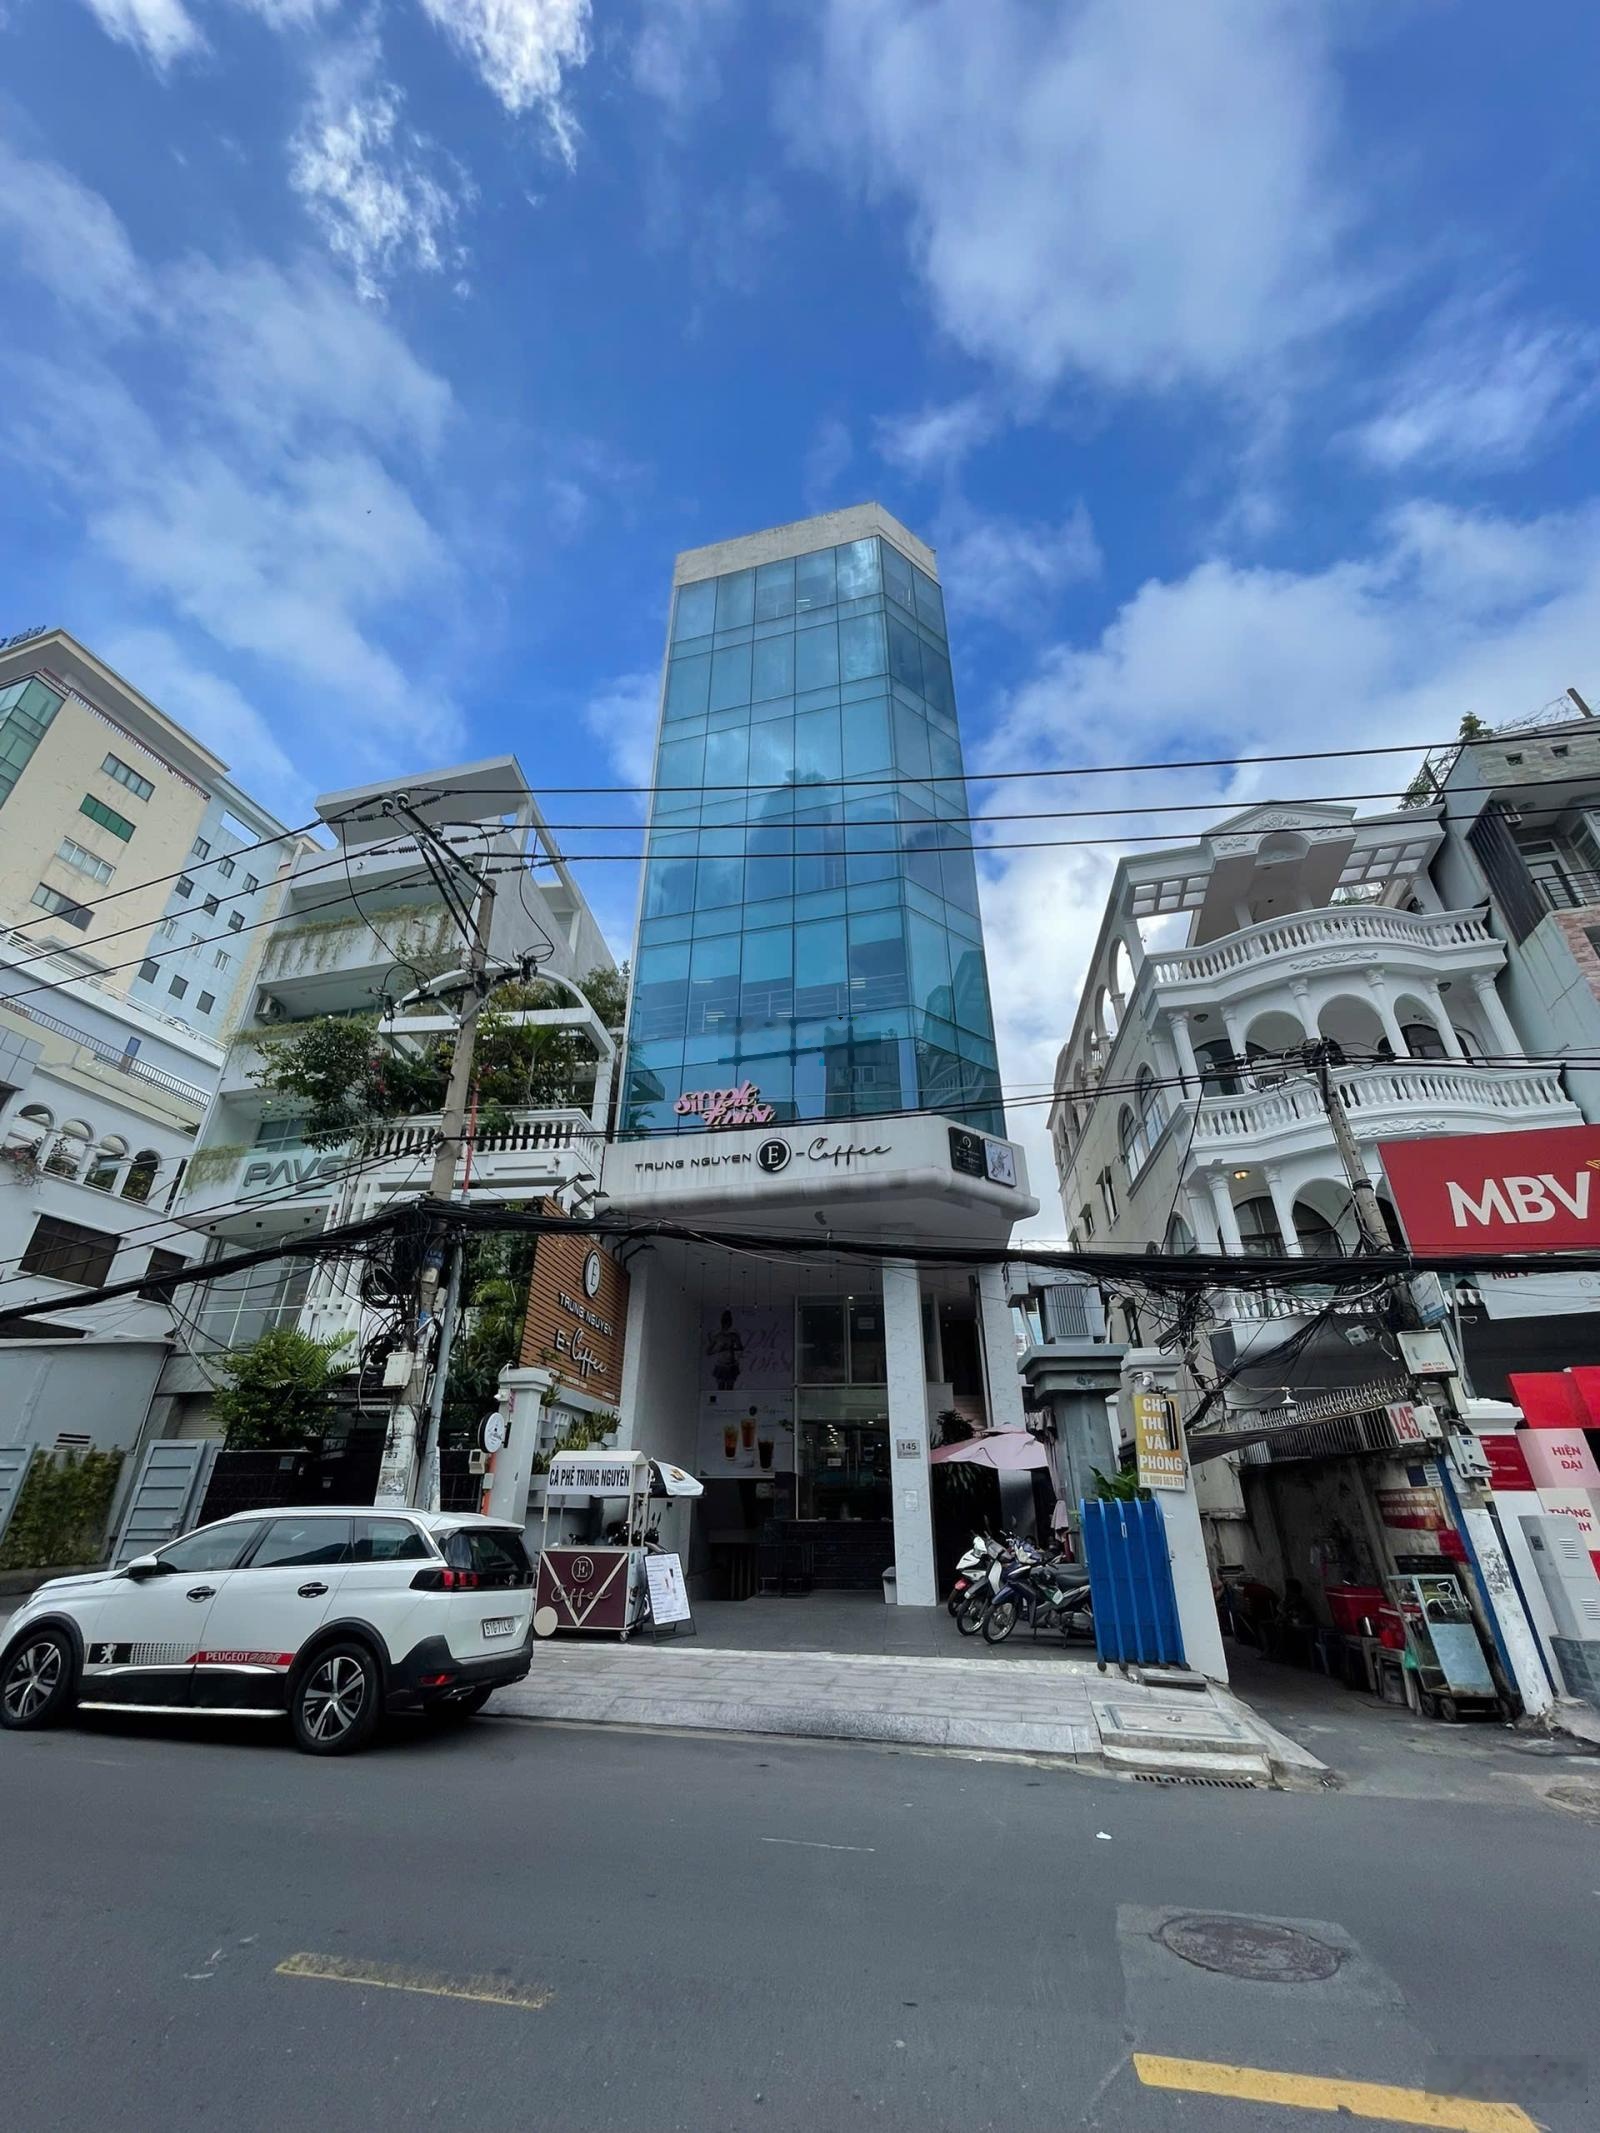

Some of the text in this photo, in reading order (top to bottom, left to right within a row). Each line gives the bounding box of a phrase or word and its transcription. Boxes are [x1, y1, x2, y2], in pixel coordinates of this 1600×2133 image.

[635, 1160, 684, 1173] TRUNG
[691, 1153, 752, 1168] NGUYEN
[1445, 1171, 1590, 1228] MBV
[559, 1292, 585, 1319] TRUNG
[1390, 1406, 1421, 1440] 145
[901, 1442, 917, 1451] 145
[1551, 1444, 1582, 1458] HIỆN
[1561, 1460, 1584, 1472] ĐẠI
[576, 1469, 600, 1486] TRUNG
[206, 1652, 250, 1662] PEUGEOT
